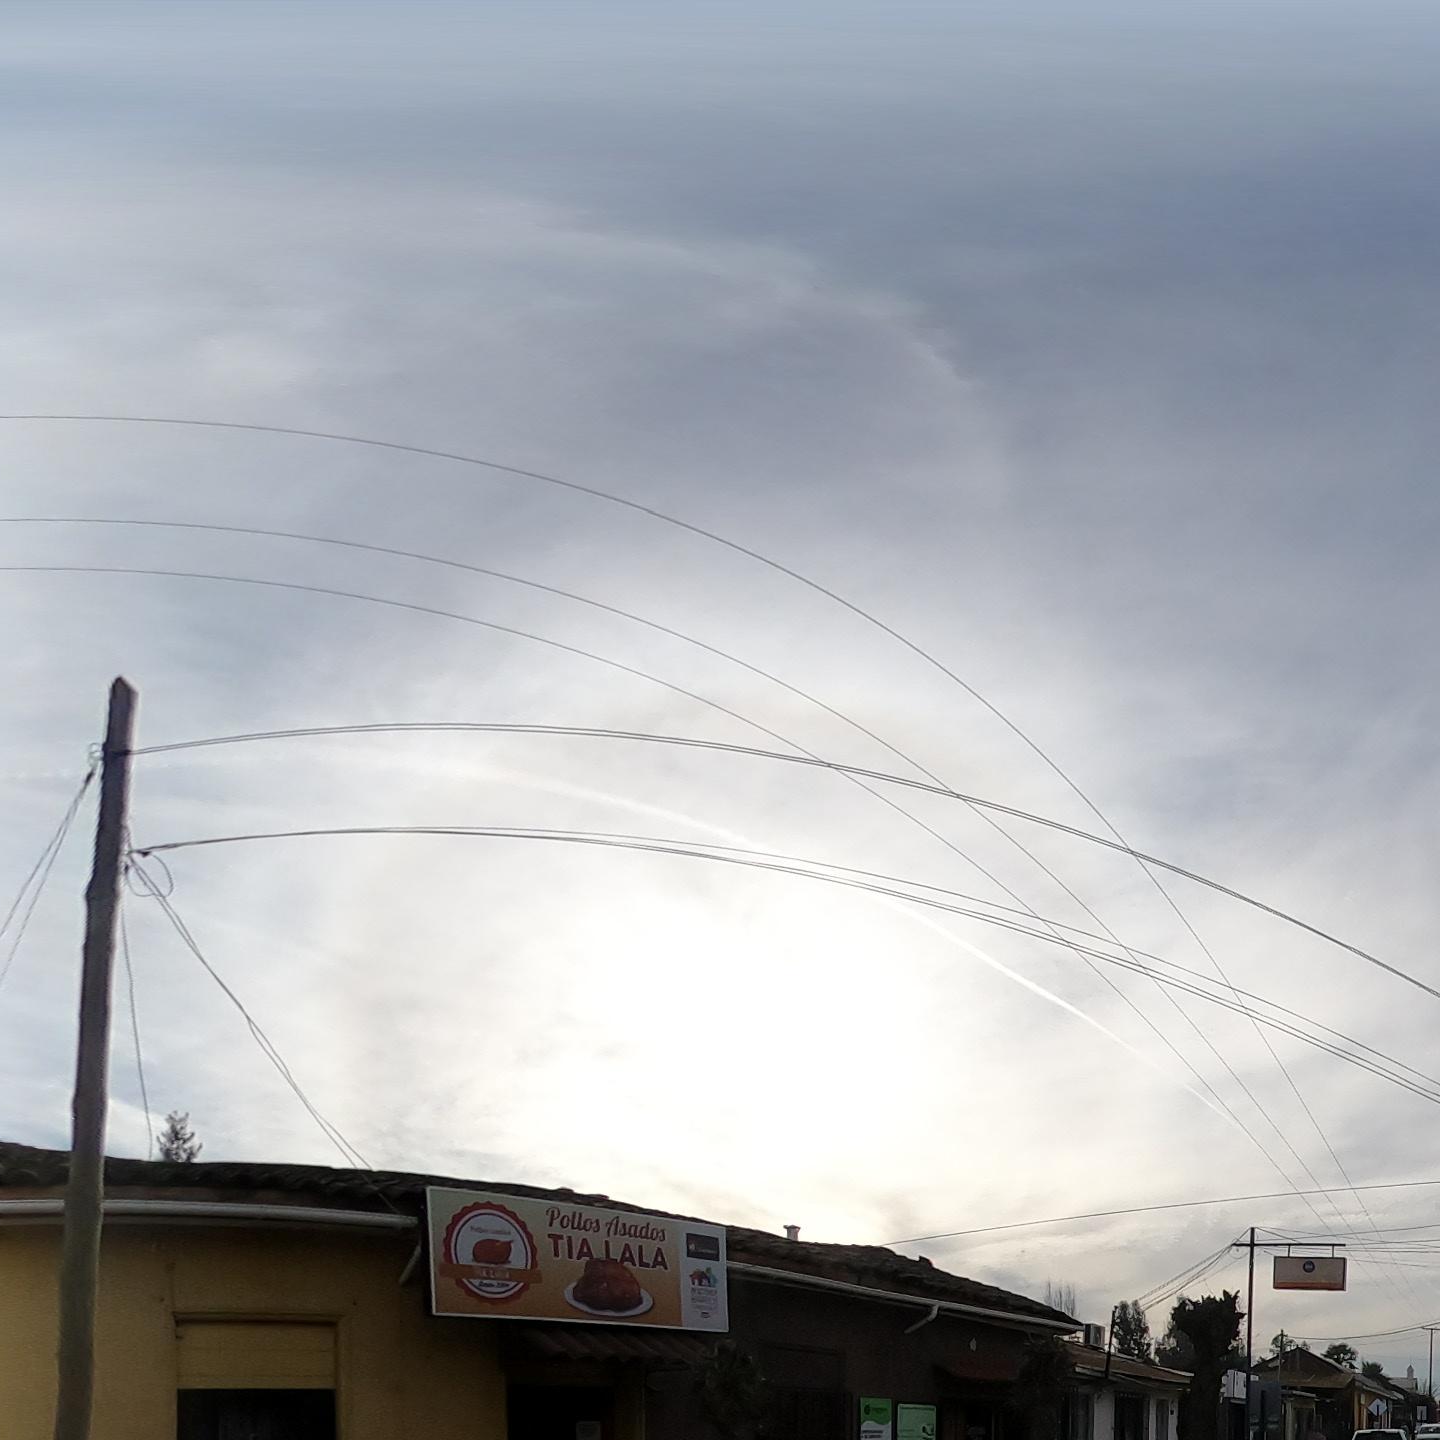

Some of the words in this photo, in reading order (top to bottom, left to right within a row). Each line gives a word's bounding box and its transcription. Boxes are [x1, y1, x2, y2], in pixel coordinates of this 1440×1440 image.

[546, 1206, 601, 1233] Pollos
[605, 1215, 666, 1242] Asados
[547, 1233, 594, 1260] TIA
[604, 1239, 669, 1271] LALA
